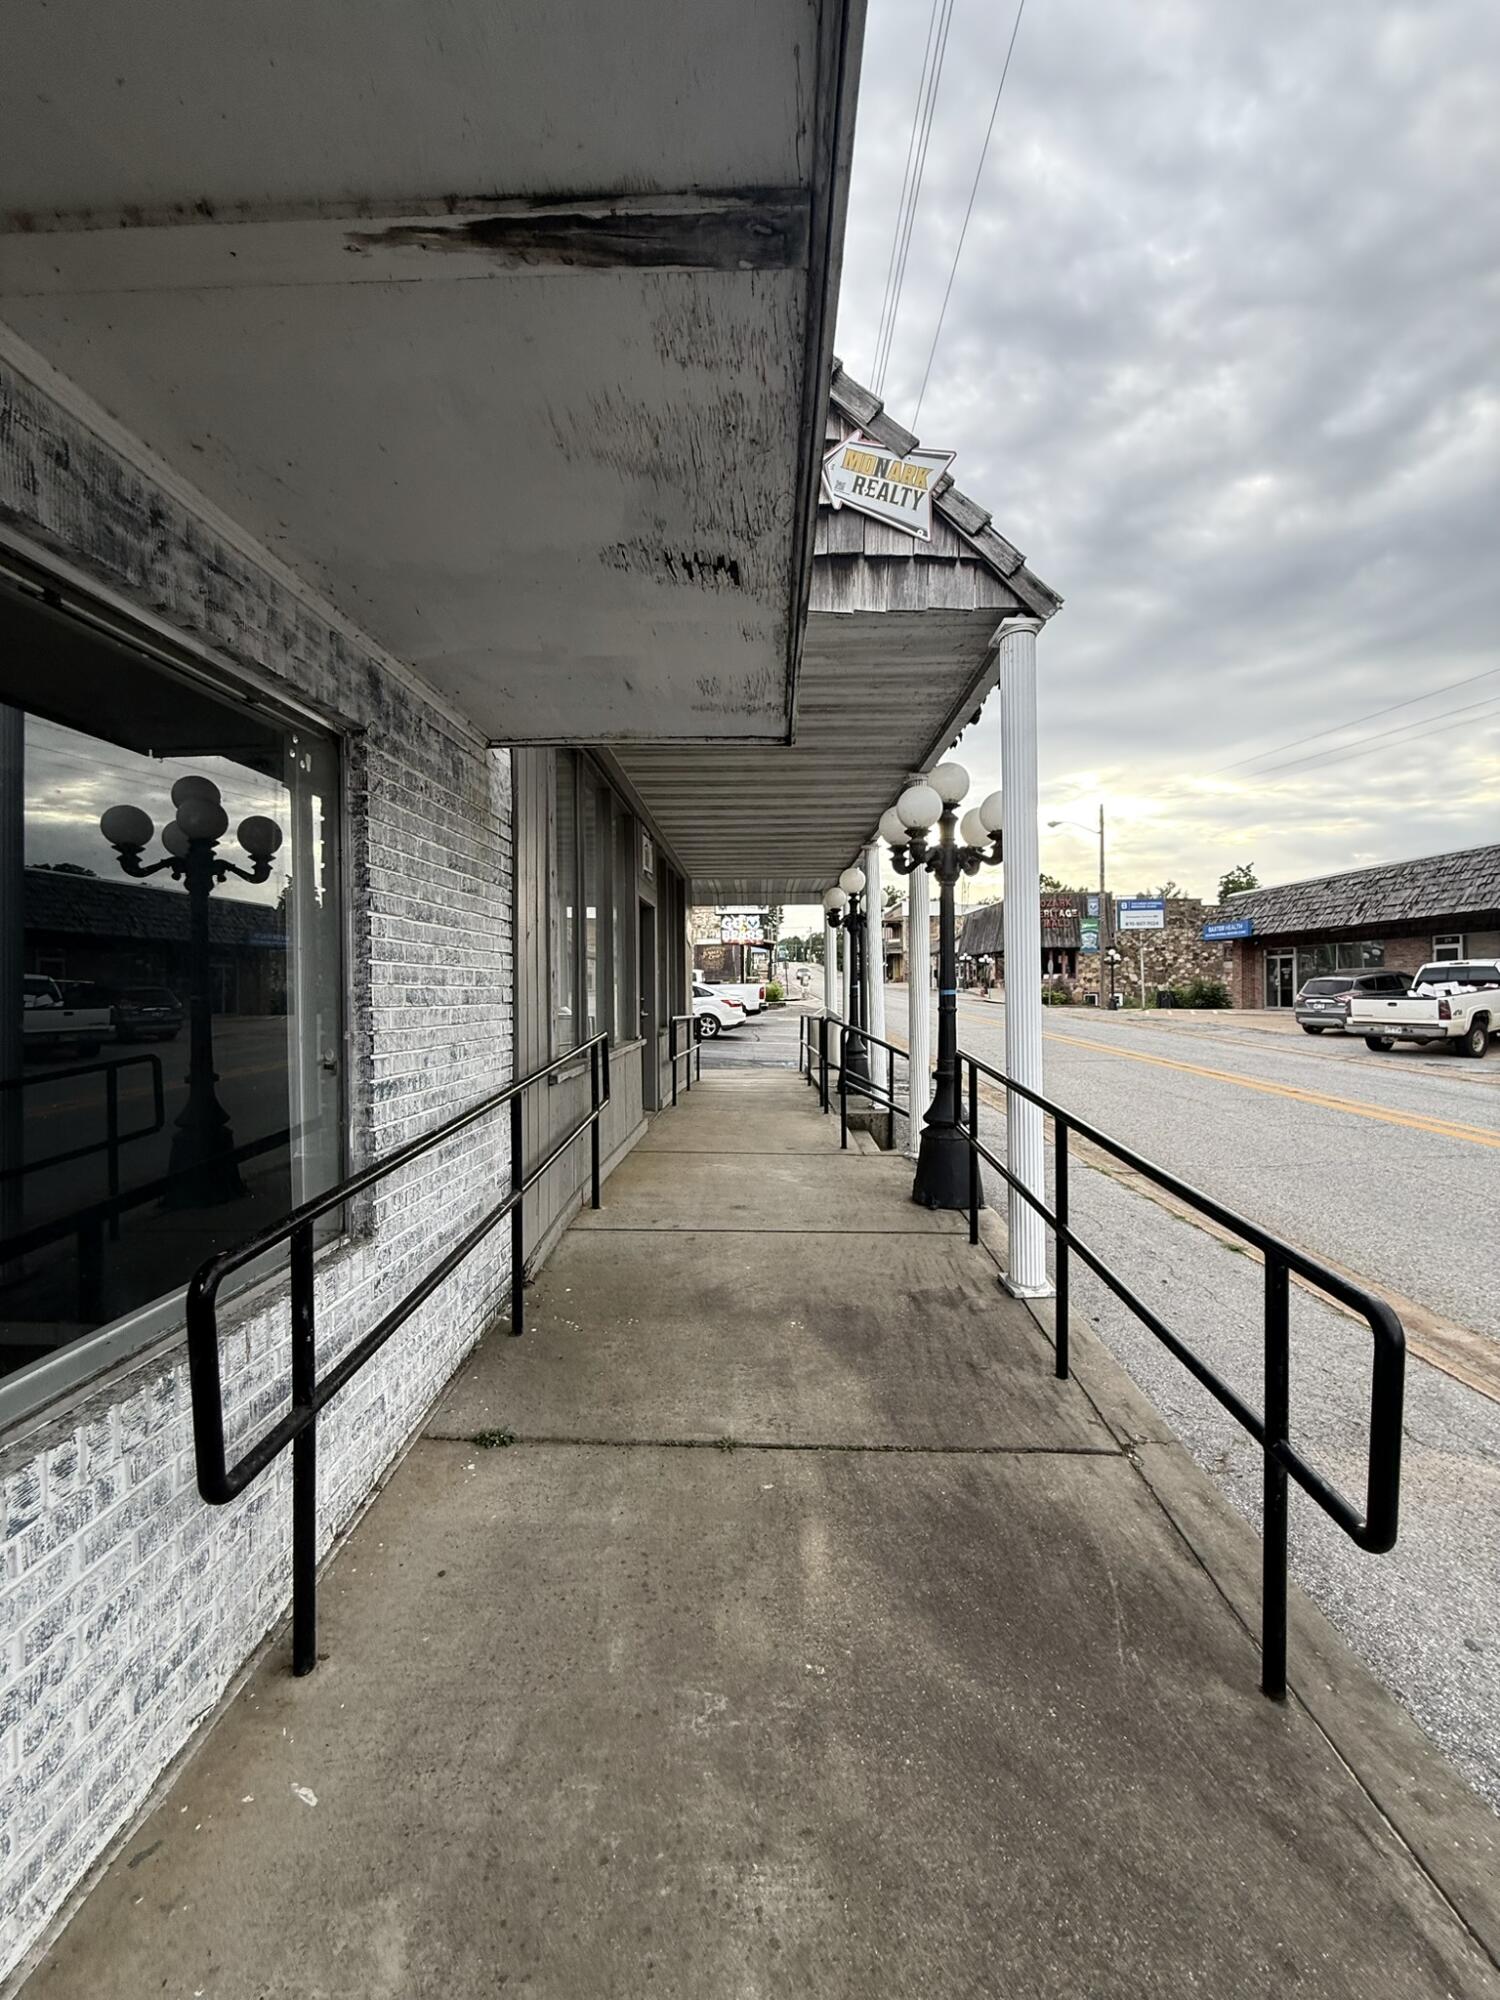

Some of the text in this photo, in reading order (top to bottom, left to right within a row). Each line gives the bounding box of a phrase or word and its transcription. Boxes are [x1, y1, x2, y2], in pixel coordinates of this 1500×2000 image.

[841, 448, 934, 490] MONARK
[852, 475, 925, 511] REALTY
[1040, 898, 1072, 907] OZARK
[1040, 908, 1079, 918] ERITAGE
